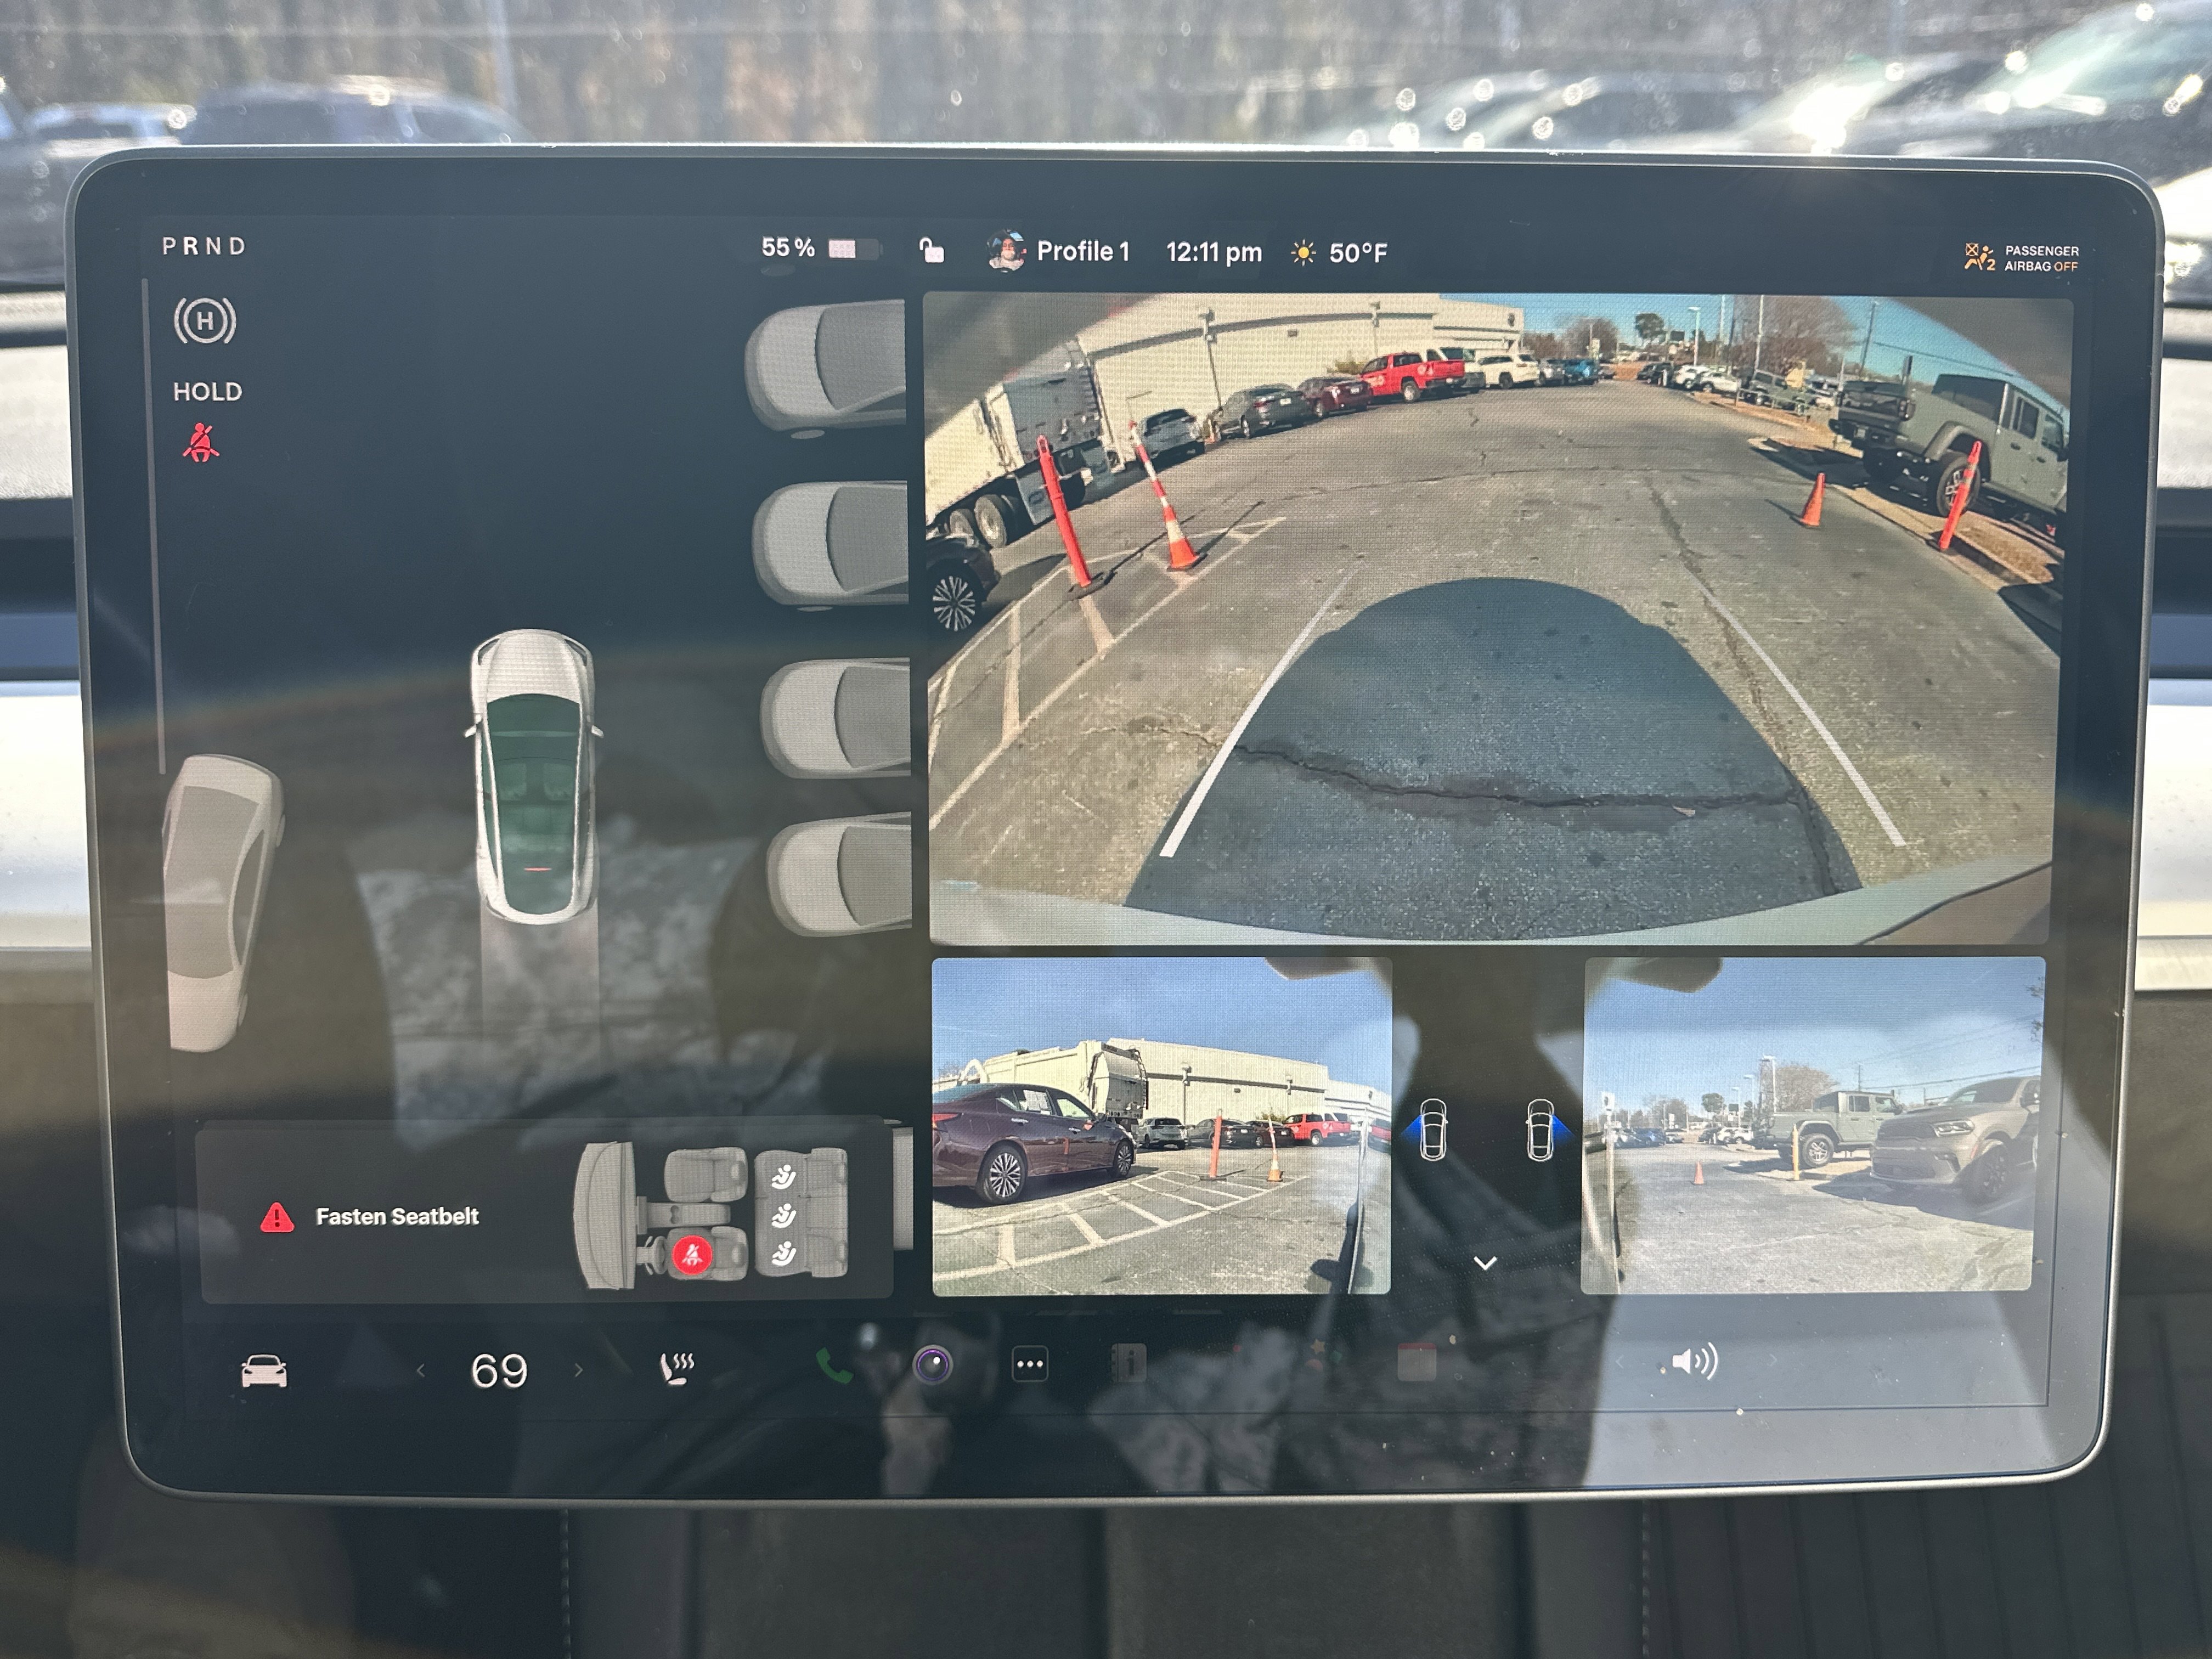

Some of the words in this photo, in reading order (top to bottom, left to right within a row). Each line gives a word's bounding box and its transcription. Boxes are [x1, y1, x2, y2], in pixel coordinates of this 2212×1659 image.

[1037, 240, 1113, 262] Profile
[1120, 241, 1129, 261] 1
[1166, 241, 1219, 262] 12:11
[1226, 245, 1262, 267] pm
[1329, 241, 1389, 263] 50°F
[2005, 245, 2080, 257] PASSENGER
[2005, 261, 2051, 272] AIRBAG
[2053, 262, 2079, 272] OFF
[174, 382, 242, 401] HOLD
[315, 1207, 386, 1226] Fasten
[391, 1206, 480, 1226] Seatbelt
[471, 1352, 528, 1389] 69
